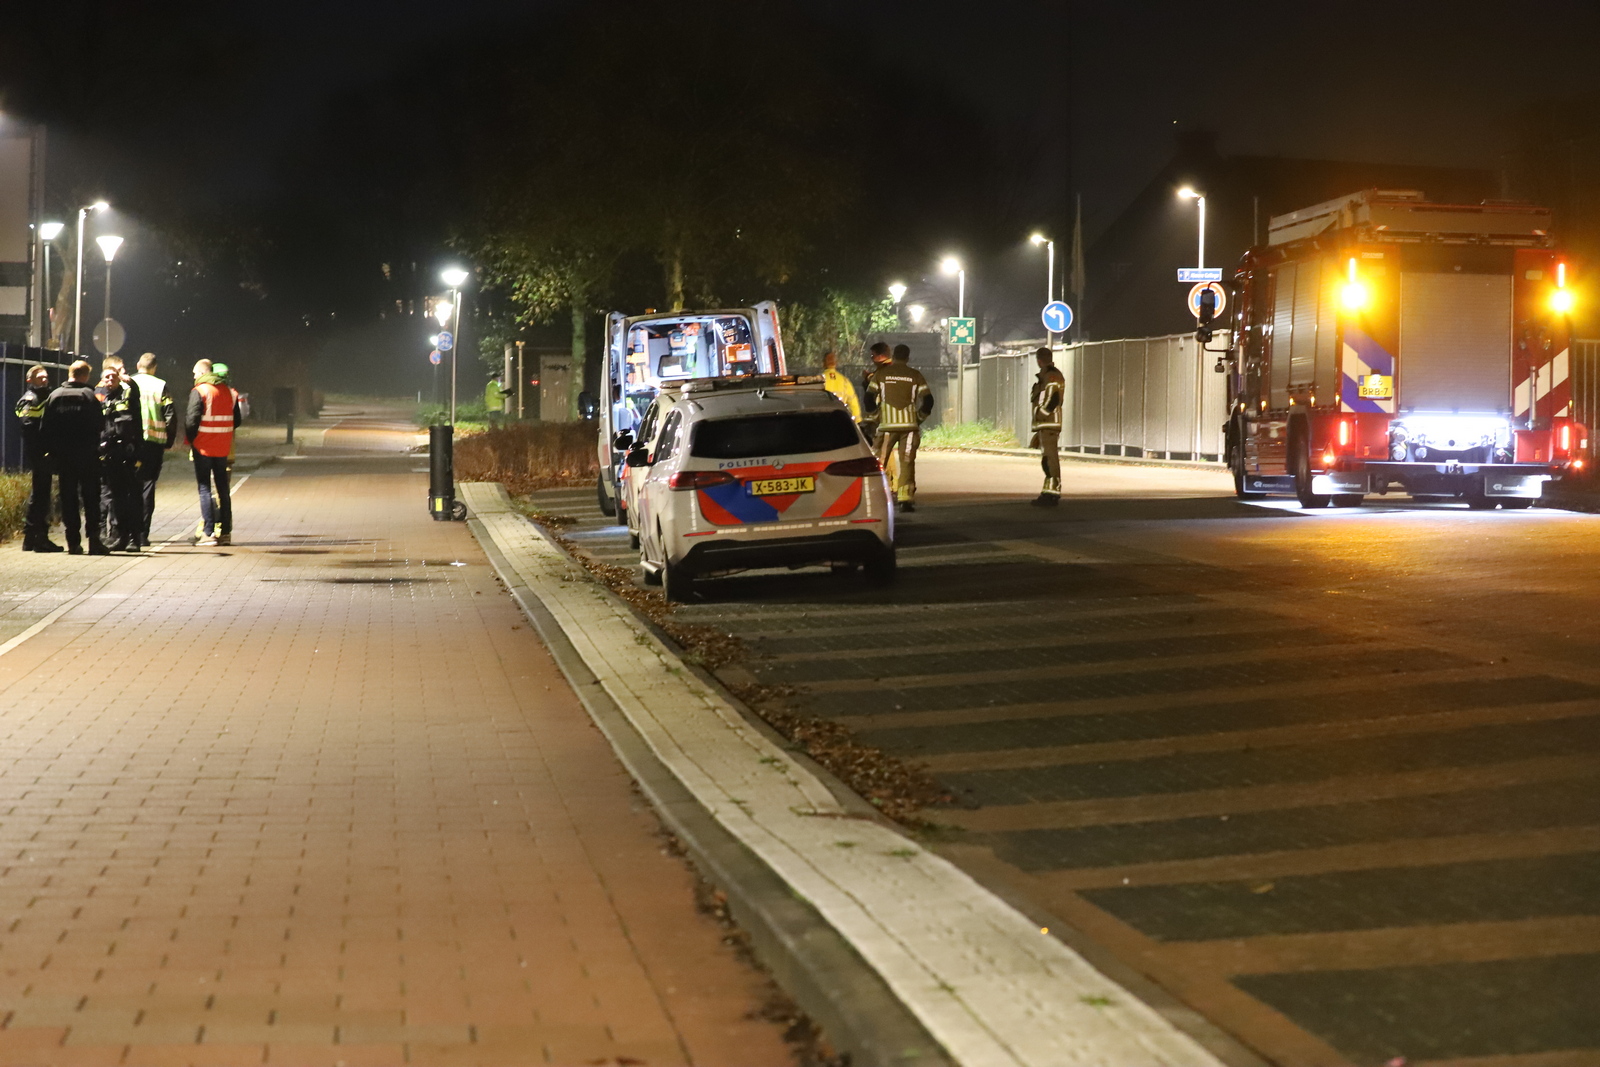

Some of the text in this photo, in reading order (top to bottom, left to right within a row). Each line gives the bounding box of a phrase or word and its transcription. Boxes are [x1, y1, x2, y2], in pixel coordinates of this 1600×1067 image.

[1362, 387, 1389, 396] BRB-7
[719, 459, 768, 469] POLITIE
[755, 479, 808, 493] X-583-JK
